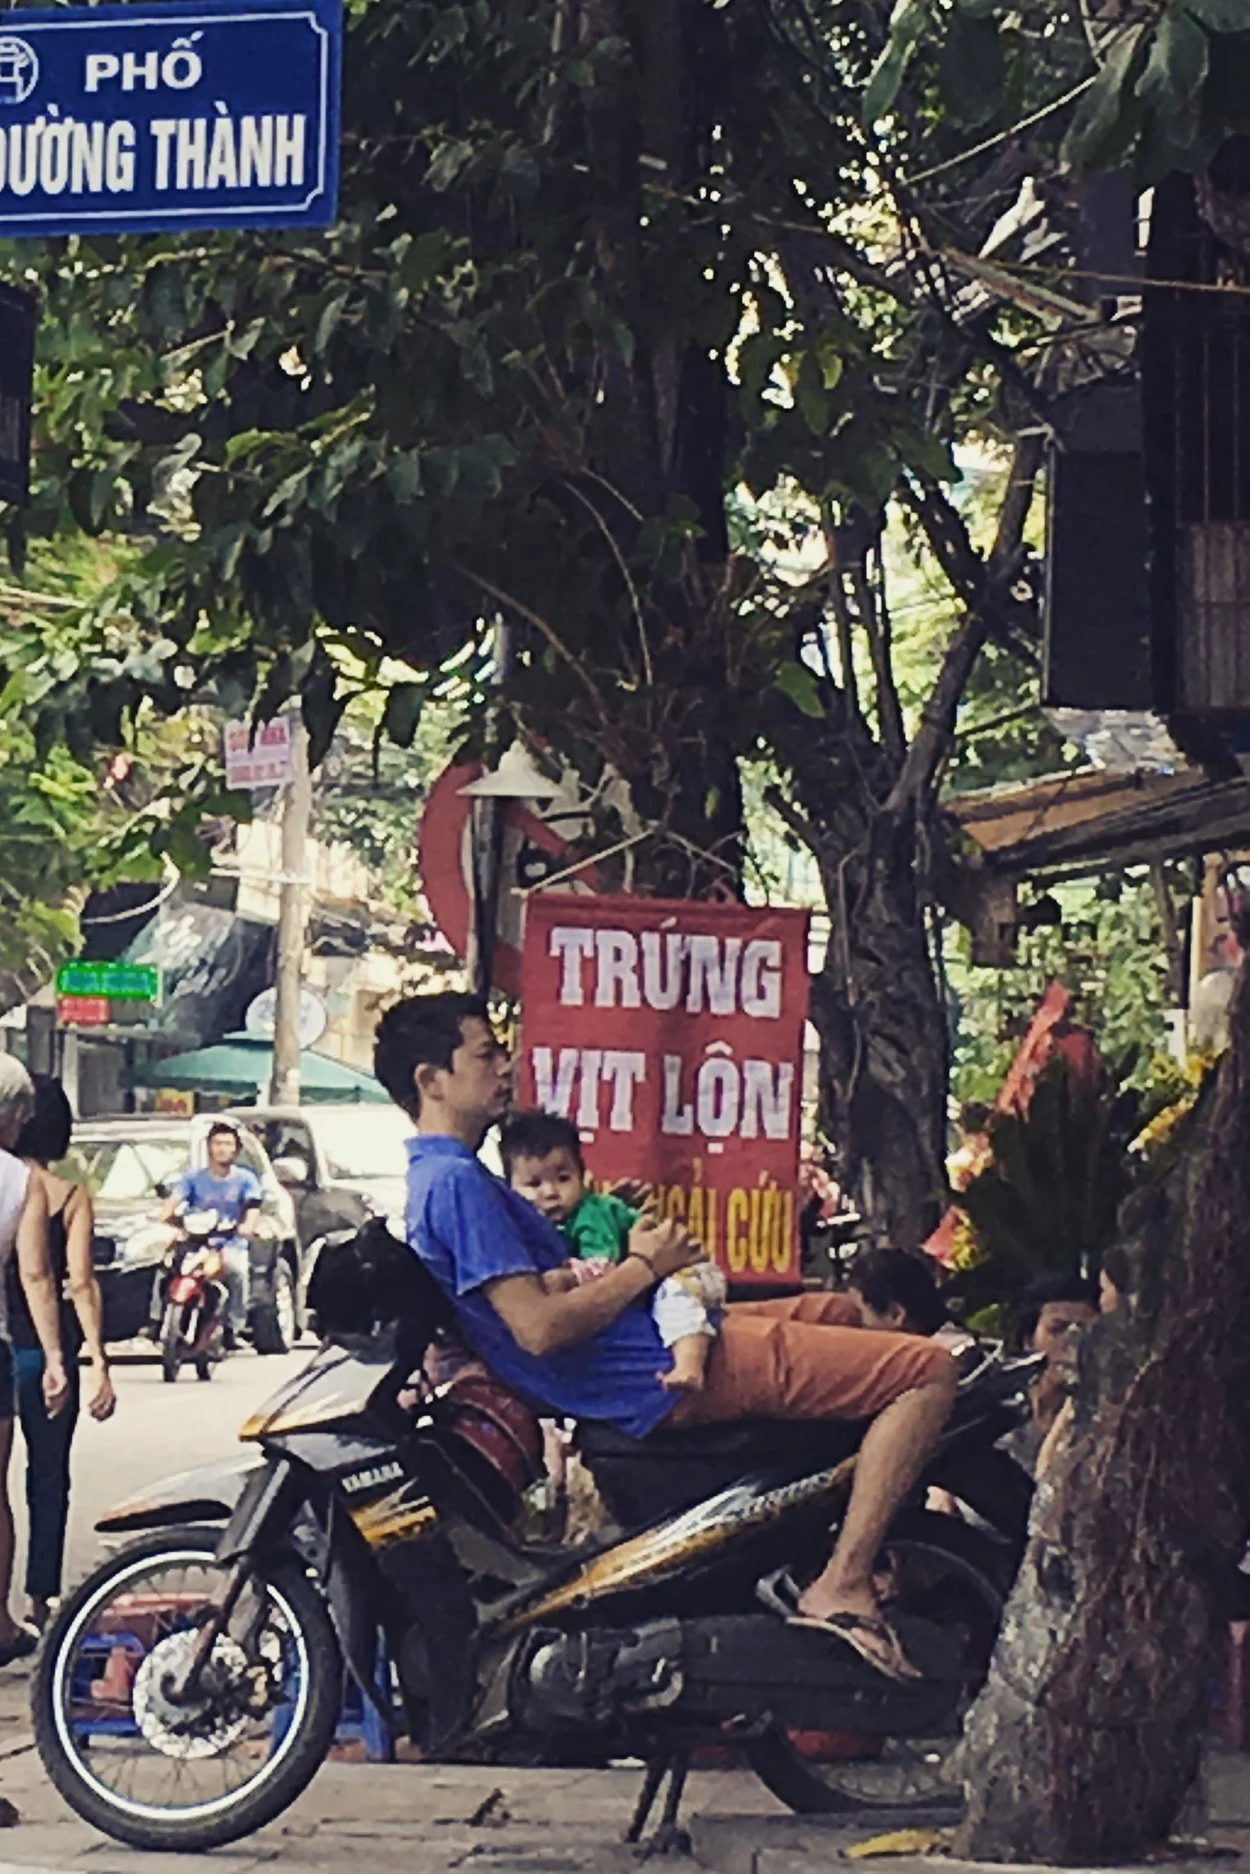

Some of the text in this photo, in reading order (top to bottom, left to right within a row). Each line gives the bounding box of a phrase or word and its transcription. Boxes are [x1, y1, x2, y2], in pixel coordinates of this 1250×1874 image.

[84, 31, 204, 93] PHỐ
[150, 101, 306, 190] THÀNH
[550, 916, 782, 1019] TRỨNG
[532, 1041, 795, 1154] VỊT LỘN
[726, 1169, 793, 1274] CỨU
